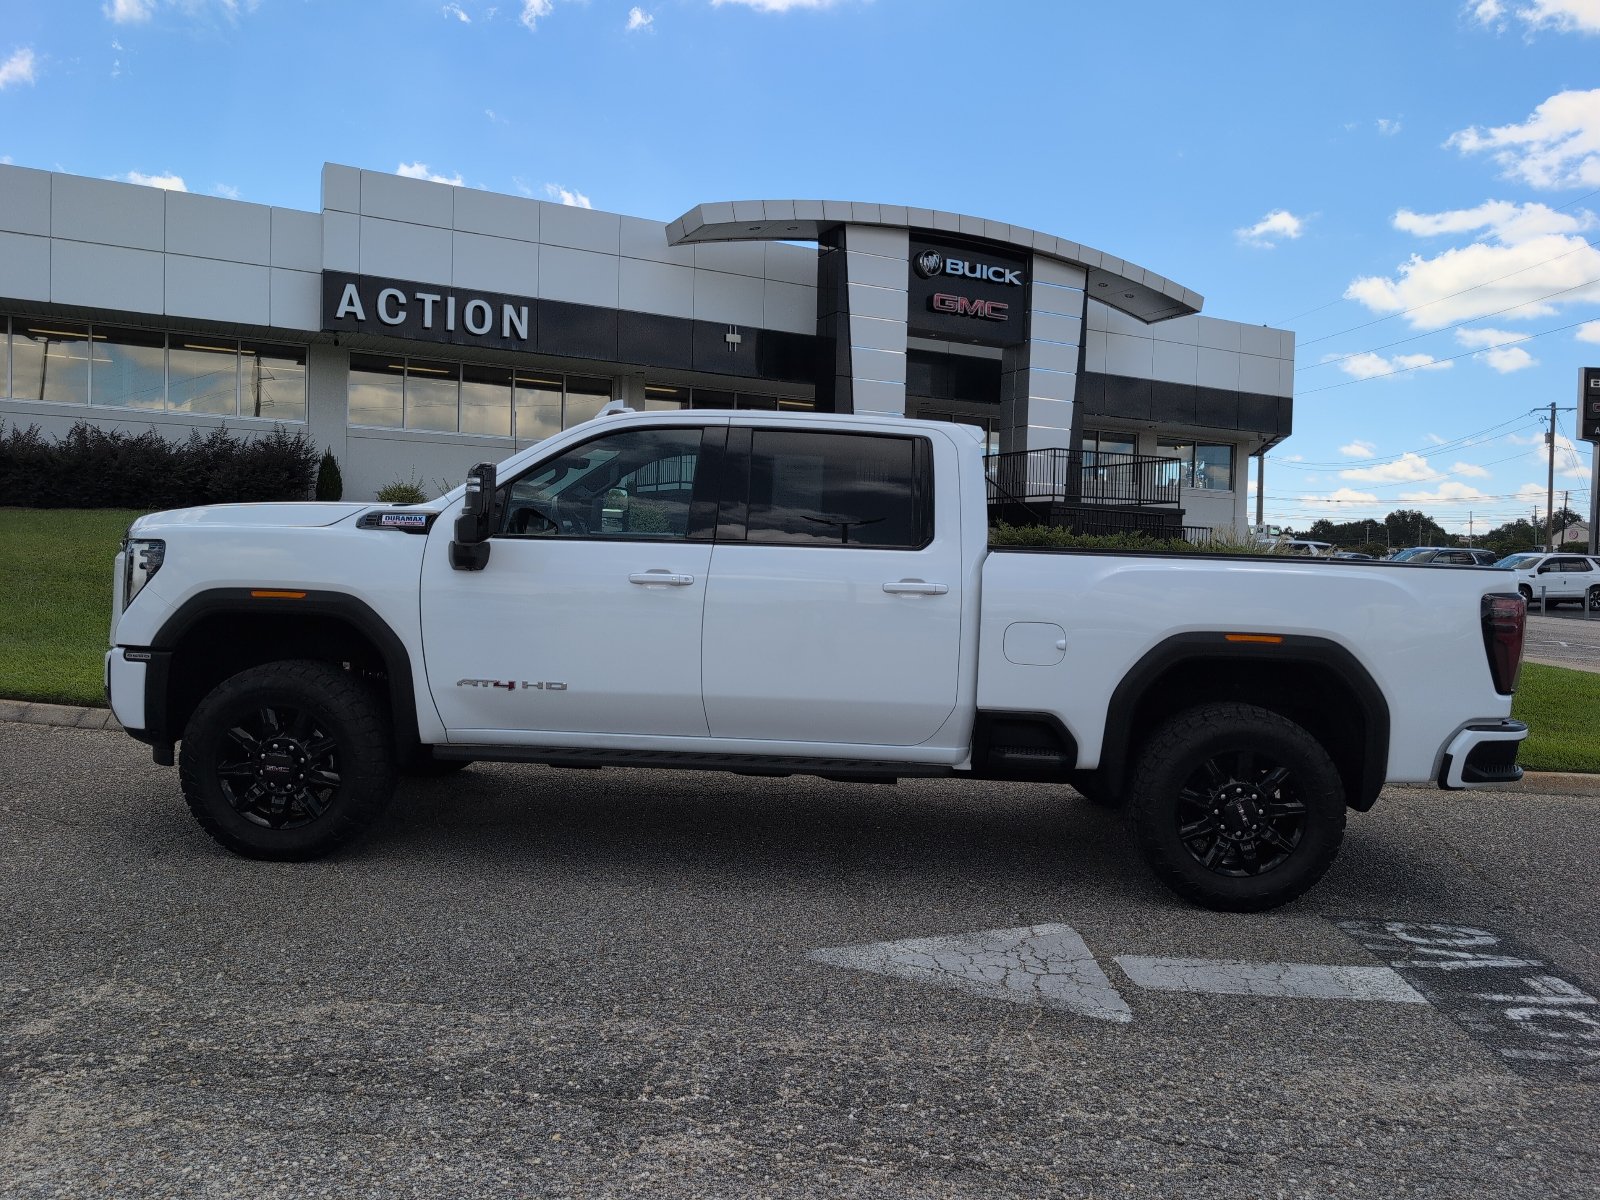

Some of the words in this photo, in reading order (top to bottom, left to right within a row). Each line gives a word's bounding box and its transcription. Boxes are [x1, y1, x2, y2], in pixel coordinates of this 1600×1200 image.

[945, 258, 1022, 285] BUICK
[336, 283, 529, 339] ACTION
[933, 292, 1009, 320] GMC
